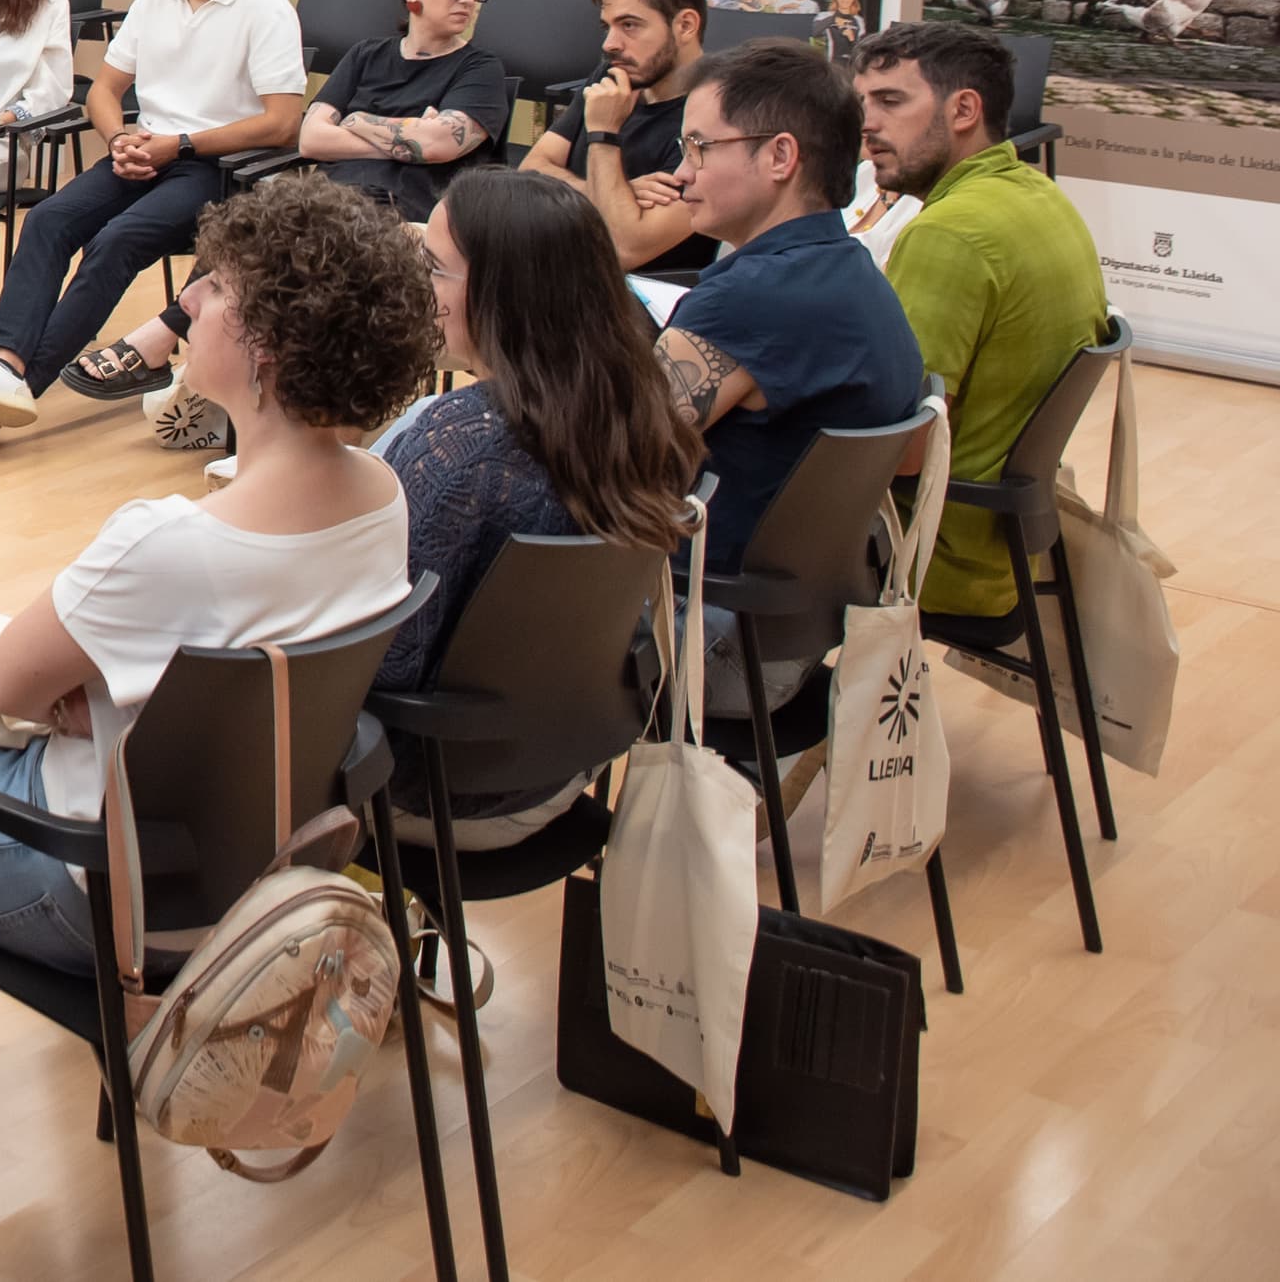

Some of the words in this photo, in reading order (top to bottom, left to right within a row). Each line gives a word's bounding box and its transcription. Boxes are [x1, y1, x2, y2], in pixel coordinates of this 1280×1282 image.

[1064, 134, 1092, 149] Dels
[1095, 138, 1148, 156] Pirineus
[1151, 149, 1159, 157] a
[1162, 146, 1174, 159] la
[1178, 150, 1215, 164] plana
[1218, 153, 1235, 167] de
[1100, 256, 1161, 274] Diputació
[1164, 266, 1179, 276] de
[1181, 268, 1224, 284] Lleida
